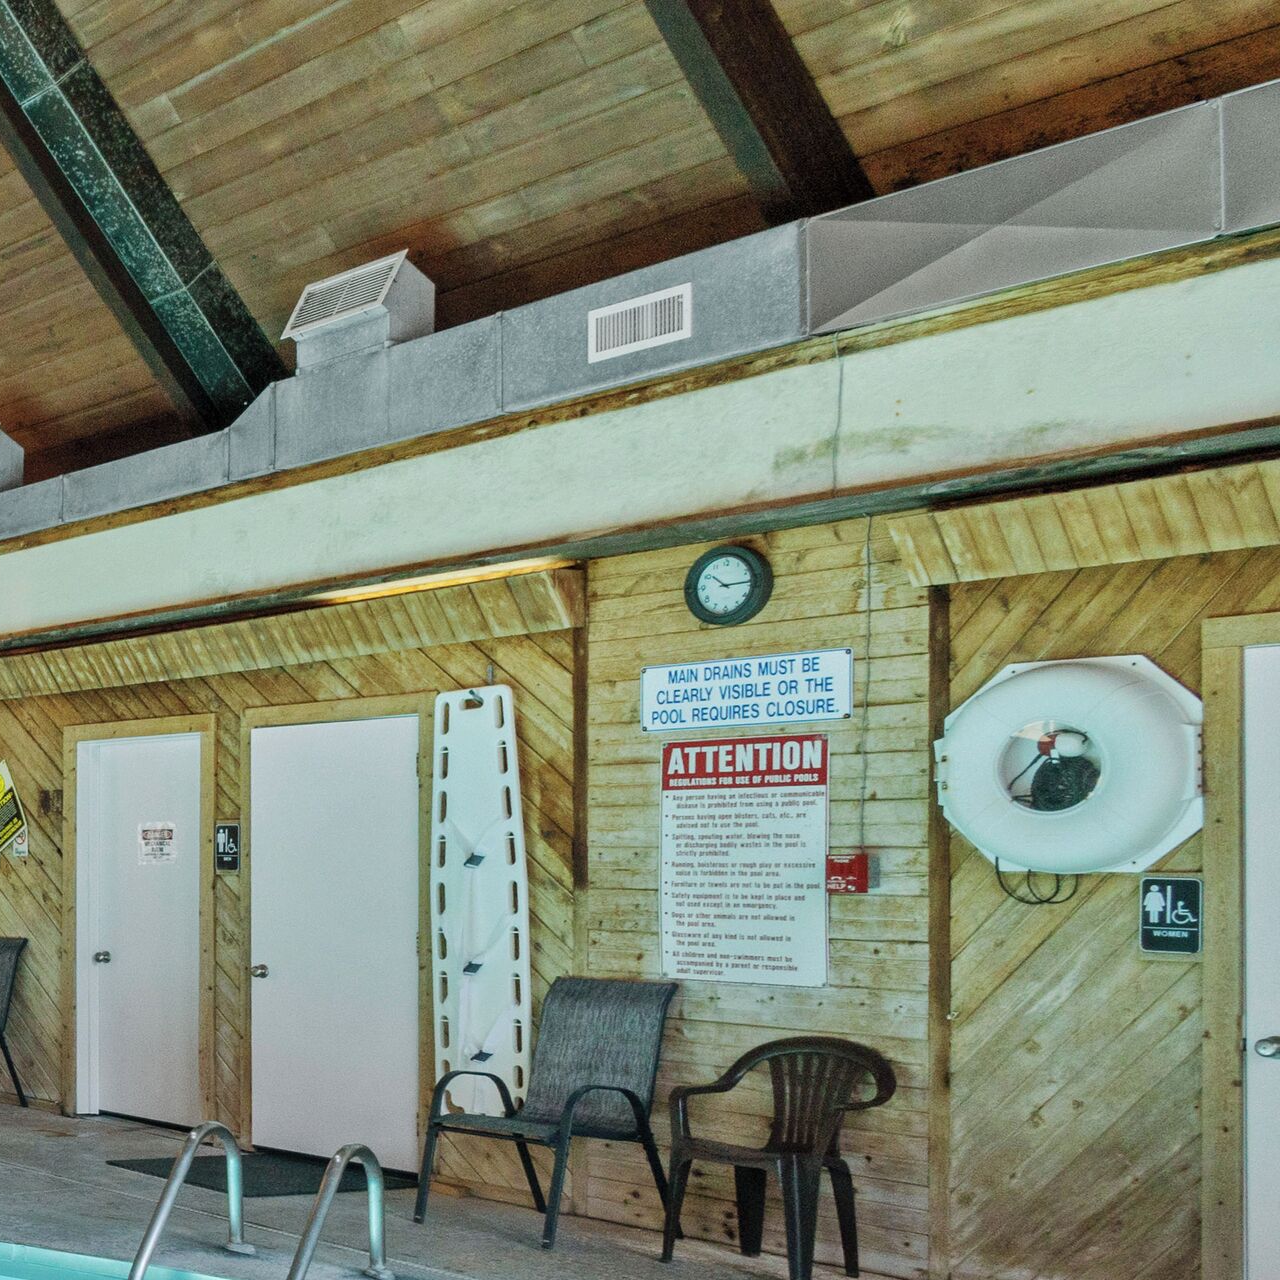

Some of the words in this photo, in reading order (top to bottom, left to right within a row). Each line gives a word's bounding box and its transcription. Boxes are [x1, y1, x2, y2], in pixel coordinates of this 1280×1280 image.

[668, 670, 698, 684] MAIN
[704, 663, 752, 681] DRAINS
[758, 659, 795, 676] MUST
[802, 657, 820, 672] BE
[657, 688, 713, 705] CLEARLY
[719, 682, 770, 700] VISIBLE
[778, 680, 797, 695] OR
[805, 677, 833, 693] THE
[652, 709, 686, 724] POOL
[692, 704, 759, 722] REQUIRES
[766, 698, 839, 717] CLOSURE.
[668, 740, 822, 774] ATTENTION
[670, 778, 716, 786] REGULATIONS
[765, 775, 791, 783] PUBLIC
